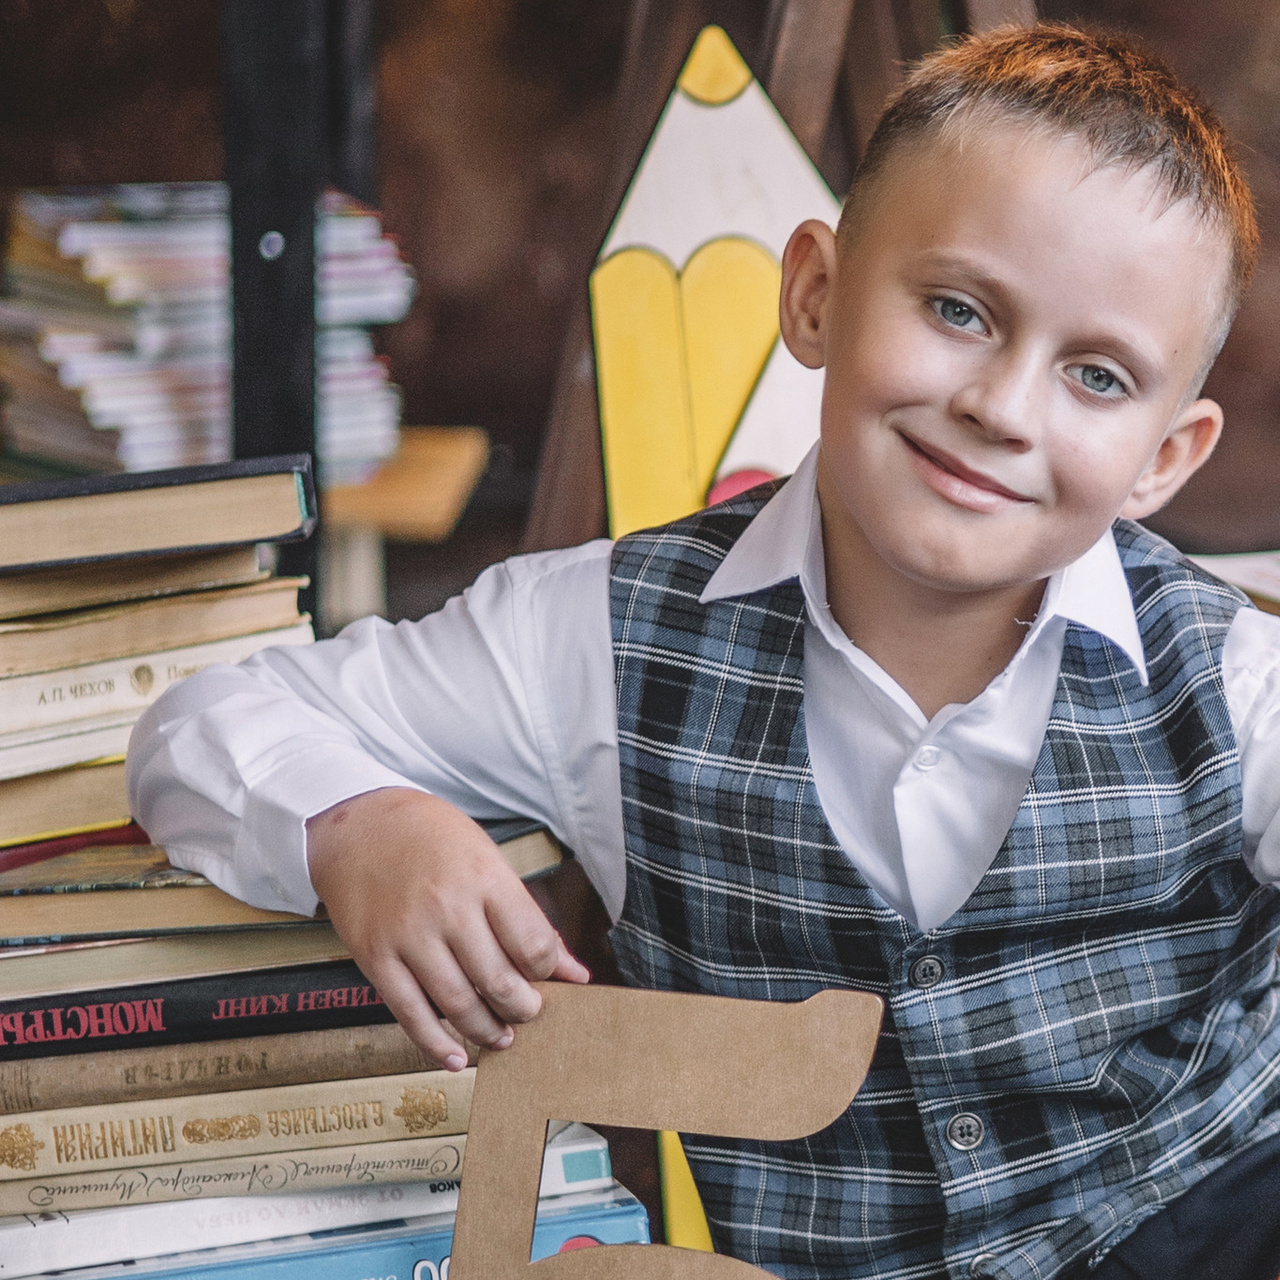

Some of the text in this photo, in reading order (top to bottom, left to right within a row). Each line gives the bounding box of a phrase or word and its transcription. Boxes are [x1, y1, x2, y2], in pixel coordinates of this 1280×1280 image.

[69, 678, 116, 699] ЧЕХОВ
[0, 985, 385, 1046] ТИВЕН КИНГ МОНСТРЫ
[52, 1116, 175, 1164] ПИТИРИМ
[28, 1143, 460, 1207] Стихотворения Александра Пушкина
